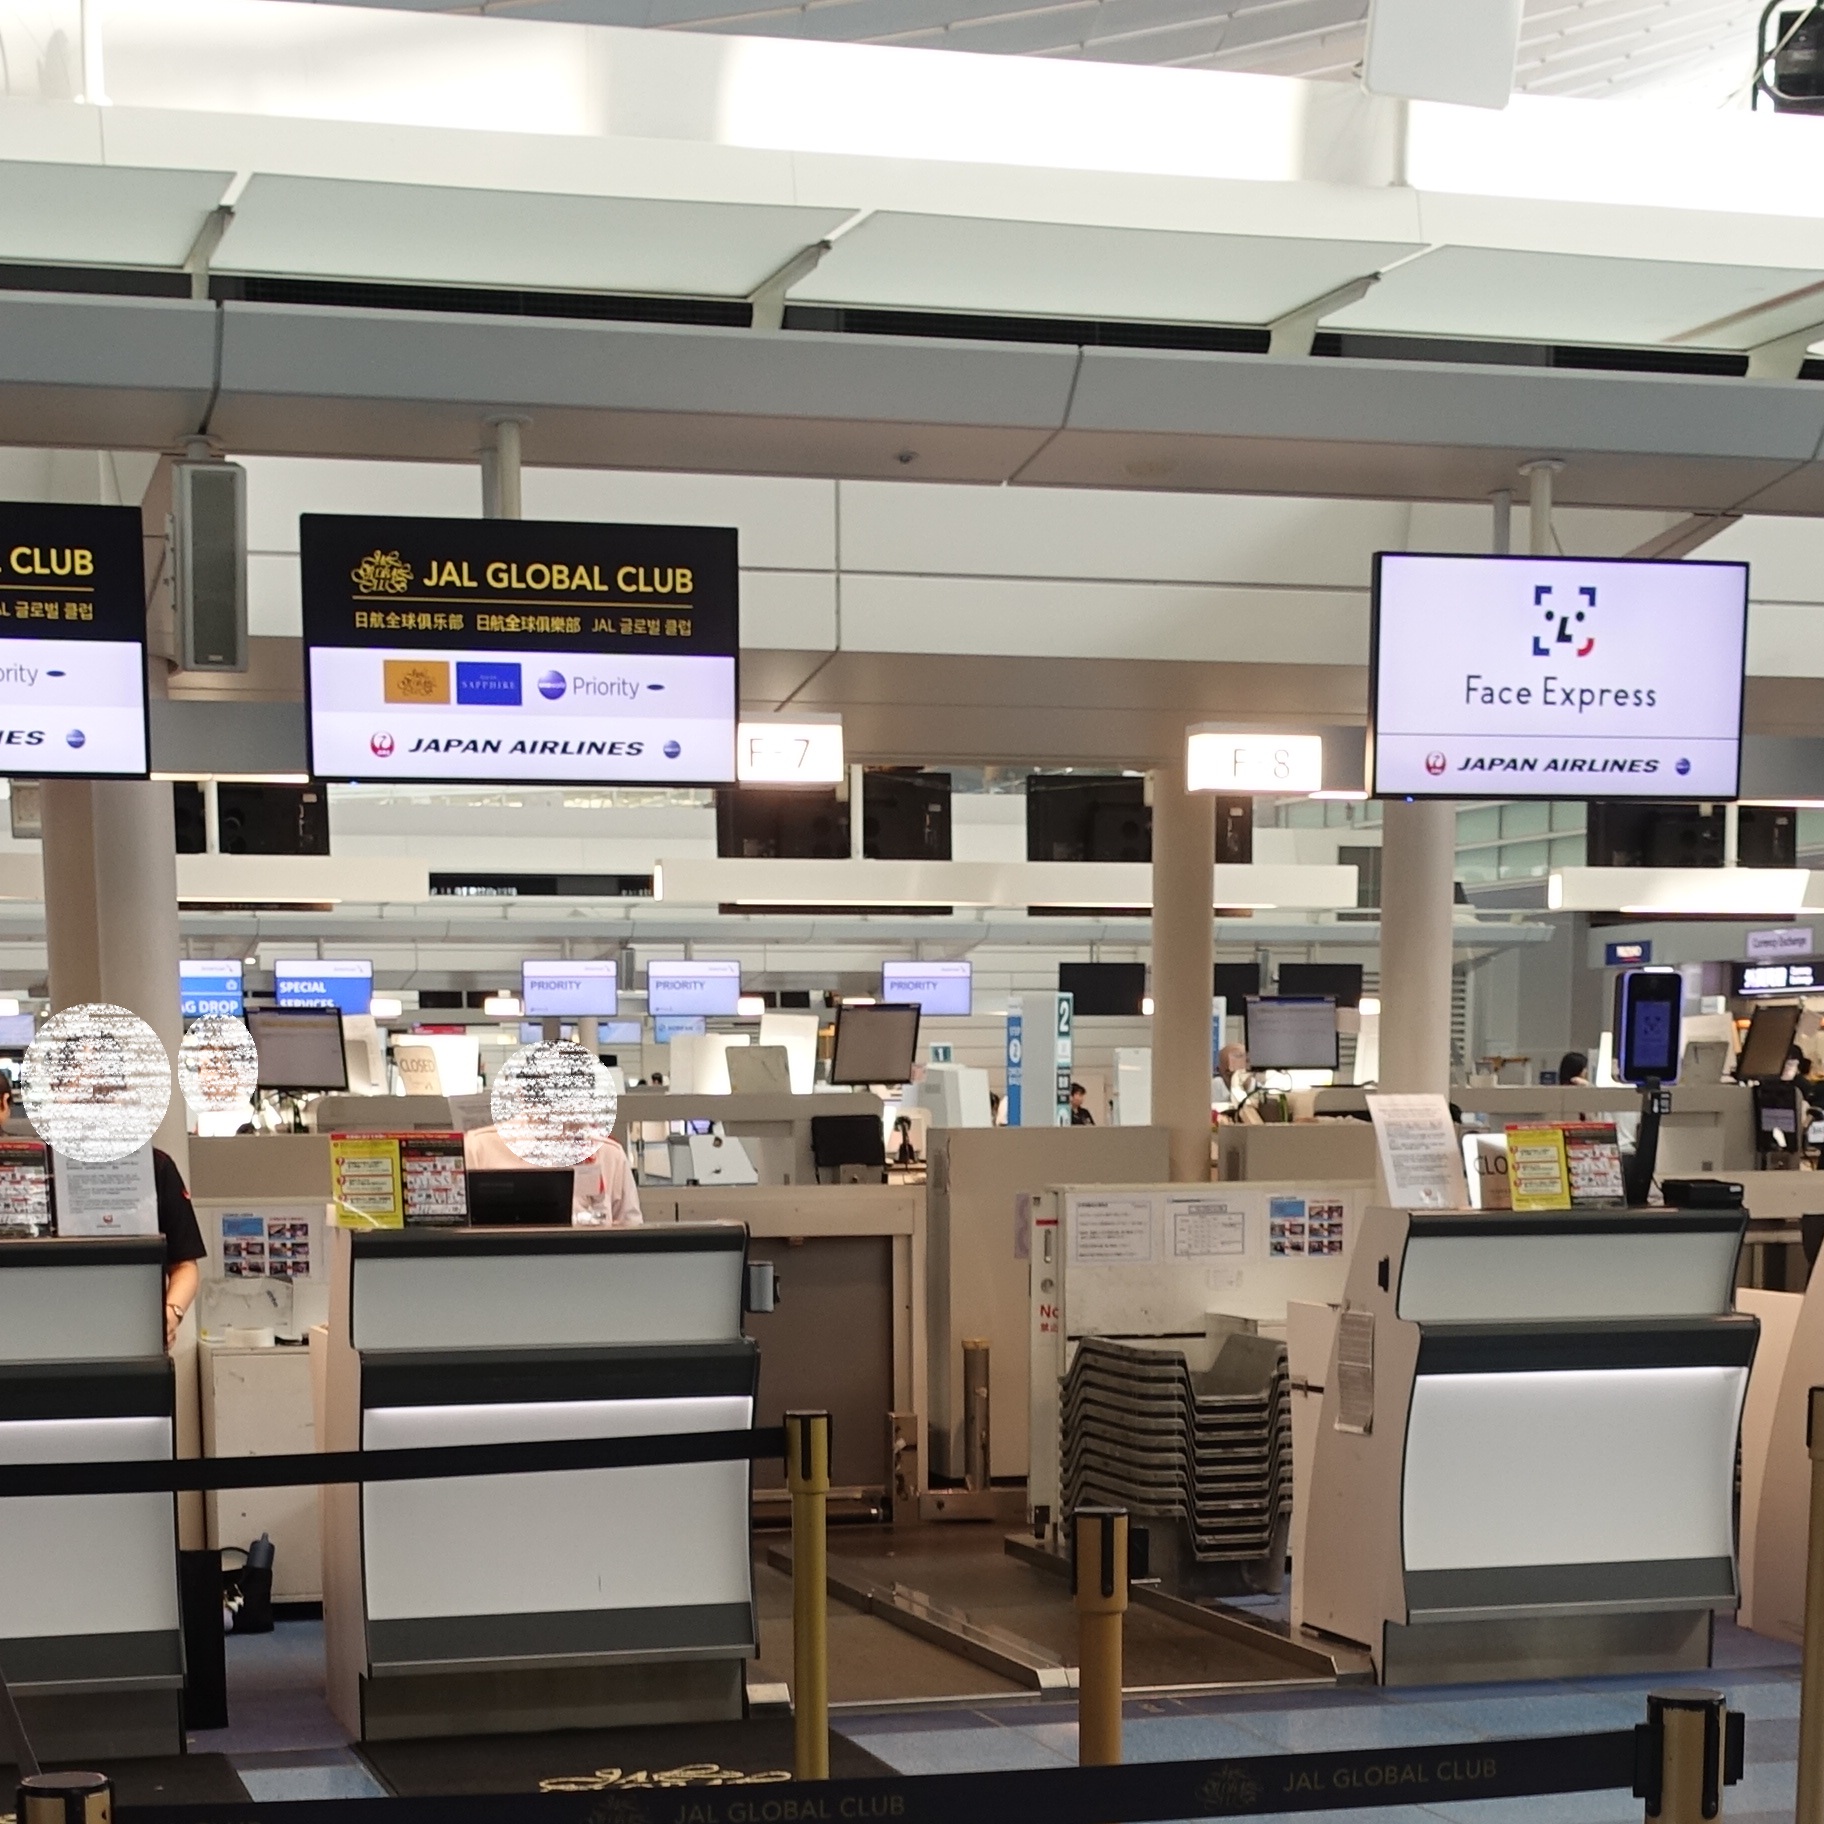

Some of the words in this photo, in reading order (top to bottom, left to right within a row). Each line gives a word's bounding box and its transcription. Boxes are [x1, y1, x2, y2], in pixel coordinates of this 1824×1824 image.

[9, 546, 95, 576] CLUB
[423, 560, 478, 588] JAL
[486, 562, 609, 591] GLOBAL
[616, 565, 693, 593] CLUB
[591, 617, 616, 633] JAL
[573, 676, 639, 700] Priority
[1465, 674, 1532, 707] Face
[1542, 676, 1657, 713] Express
[408, 738, 503, 755] JAPAN
[509, 740, 645, 757] AIRLINES
[1457, 756, 1538, 773] JAPAN
[1542, 757, 1660, 774] AIRLINES
[279, 980, 326, 994] SPECIAL
[530, 980, 582, 991] PRIORITY
[655, 980, 706, 991] PRIORITY
[889, 980, 939, 991] PRIORITY
[199, 999, 239, 1014] DROP
[1059, 1000, 1069, 1033] 2
[399, 1058, 435, 1073] CLOSED
[1283, 1771, 1325, 1793] JAL
[1333, 1764, 1428, 1790] GLOBAL
[1436, 1759, 1497, 1782] CLUB
[728, 1800, 831, 1824] GLOBAL
[840, 1796, 905, 1817] CLUB
